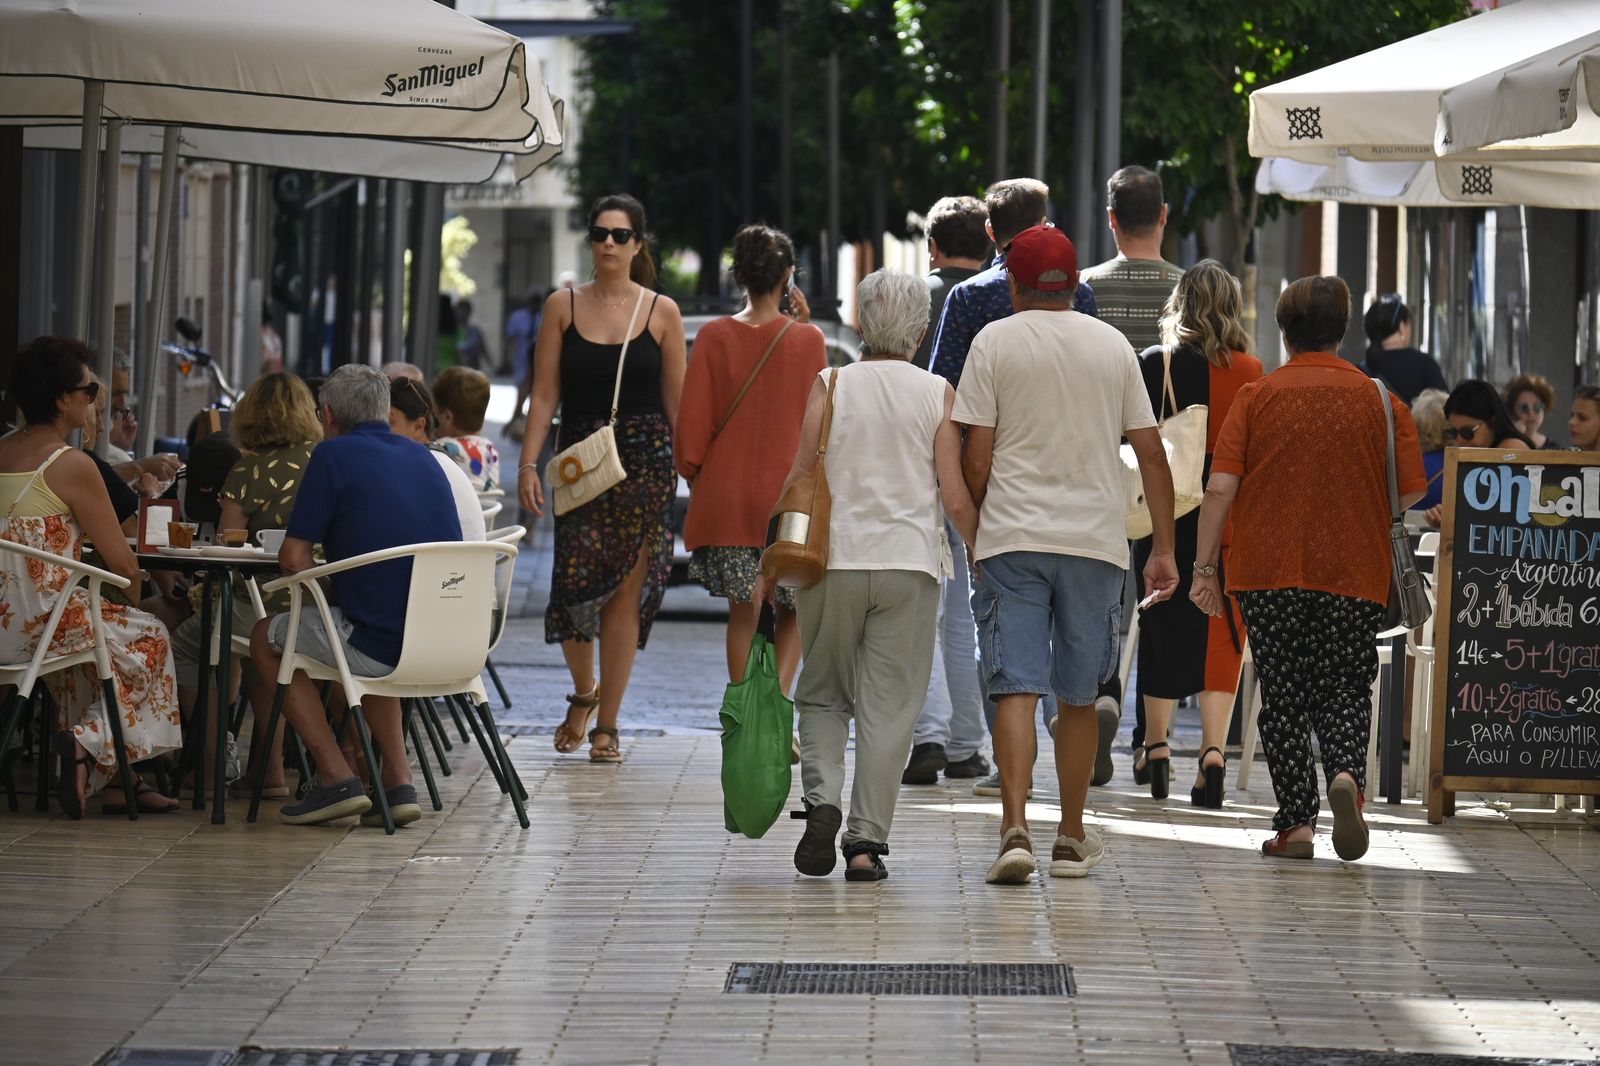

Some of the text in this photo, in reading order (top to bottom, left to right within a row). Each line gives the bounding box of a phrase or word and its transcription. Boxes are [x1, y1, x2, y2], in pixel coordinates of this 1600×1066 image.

[418, 46, 453, 55] CERVEZAS
[381, 56, 485, 97] SanMiguel
[1501, 558, 1600, 600] Argentin
[1456, 640, 1489, 665] 14€
[1471, 723, 1515, 743] PARA
